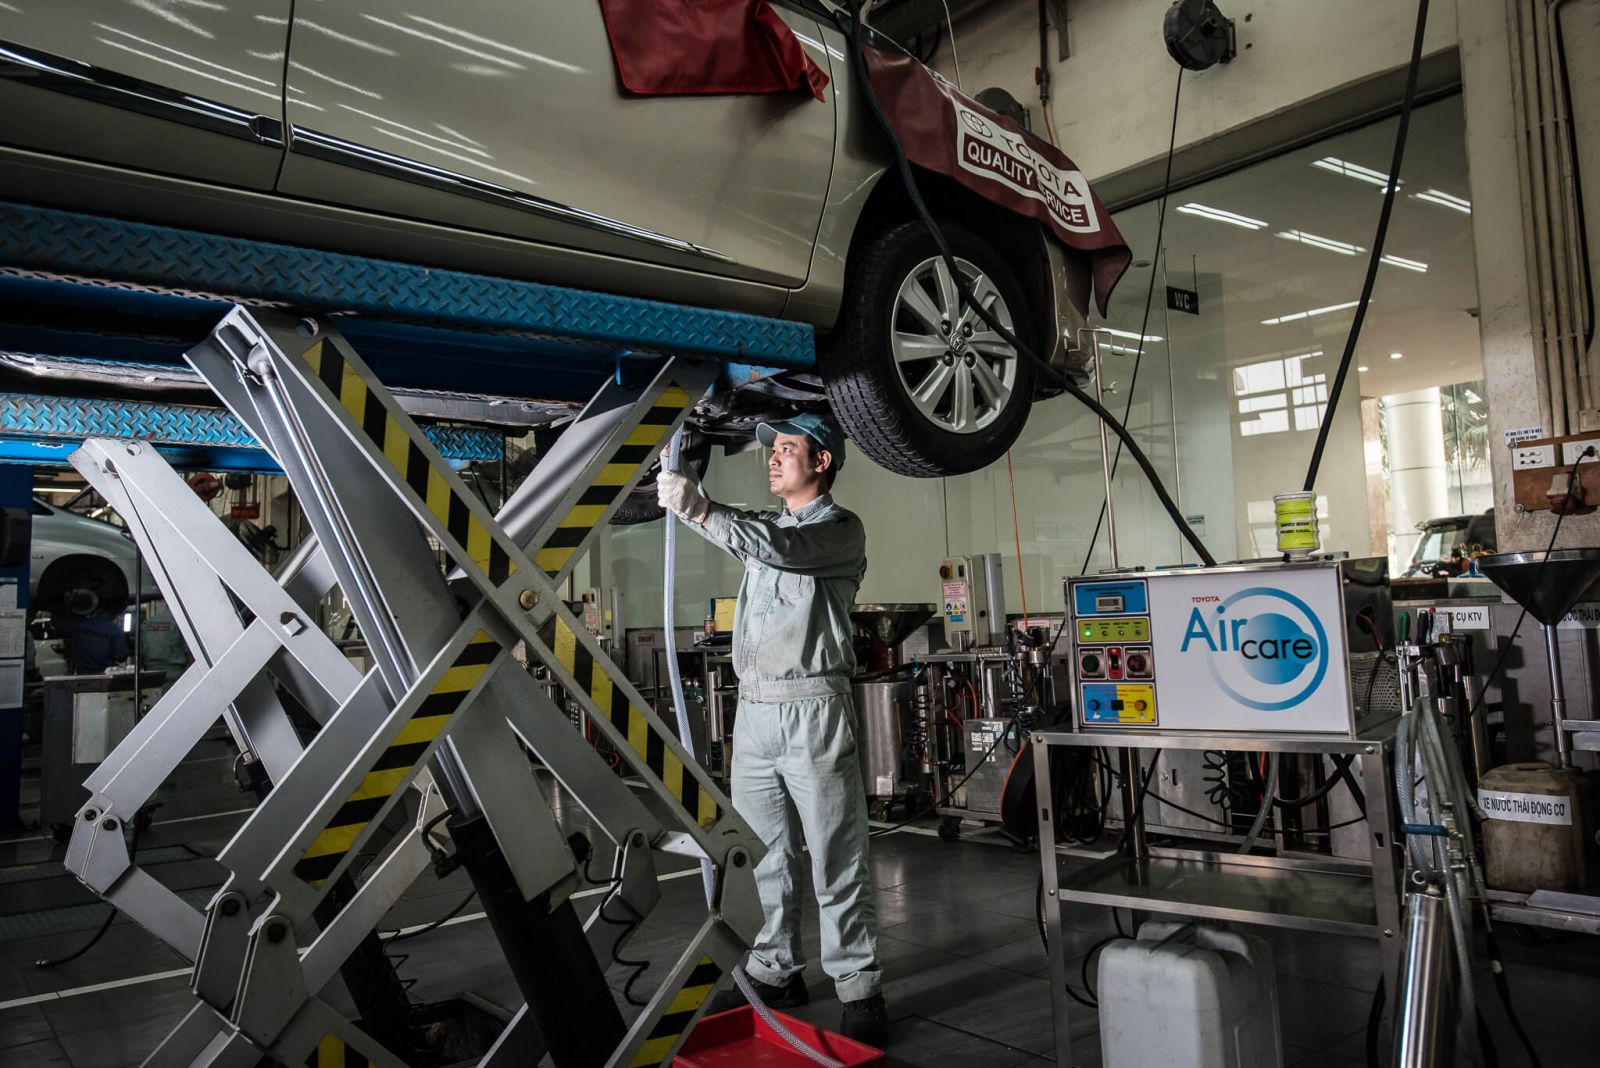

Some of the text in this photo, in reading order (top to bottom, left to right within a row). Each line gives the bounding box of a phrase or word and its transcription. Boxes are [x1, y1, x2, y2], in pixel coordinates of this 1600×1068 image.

[967, 141, 1033, 185] QUALITY
[1000, 134, 1082, 197] TOOTA
[1174, 291, 1190, 310] WC
[1180, 605, 1313, 660] Air care
[1456, 612, 1467, 623] CỤ
[1468, 612, 1482, 622] KTV
